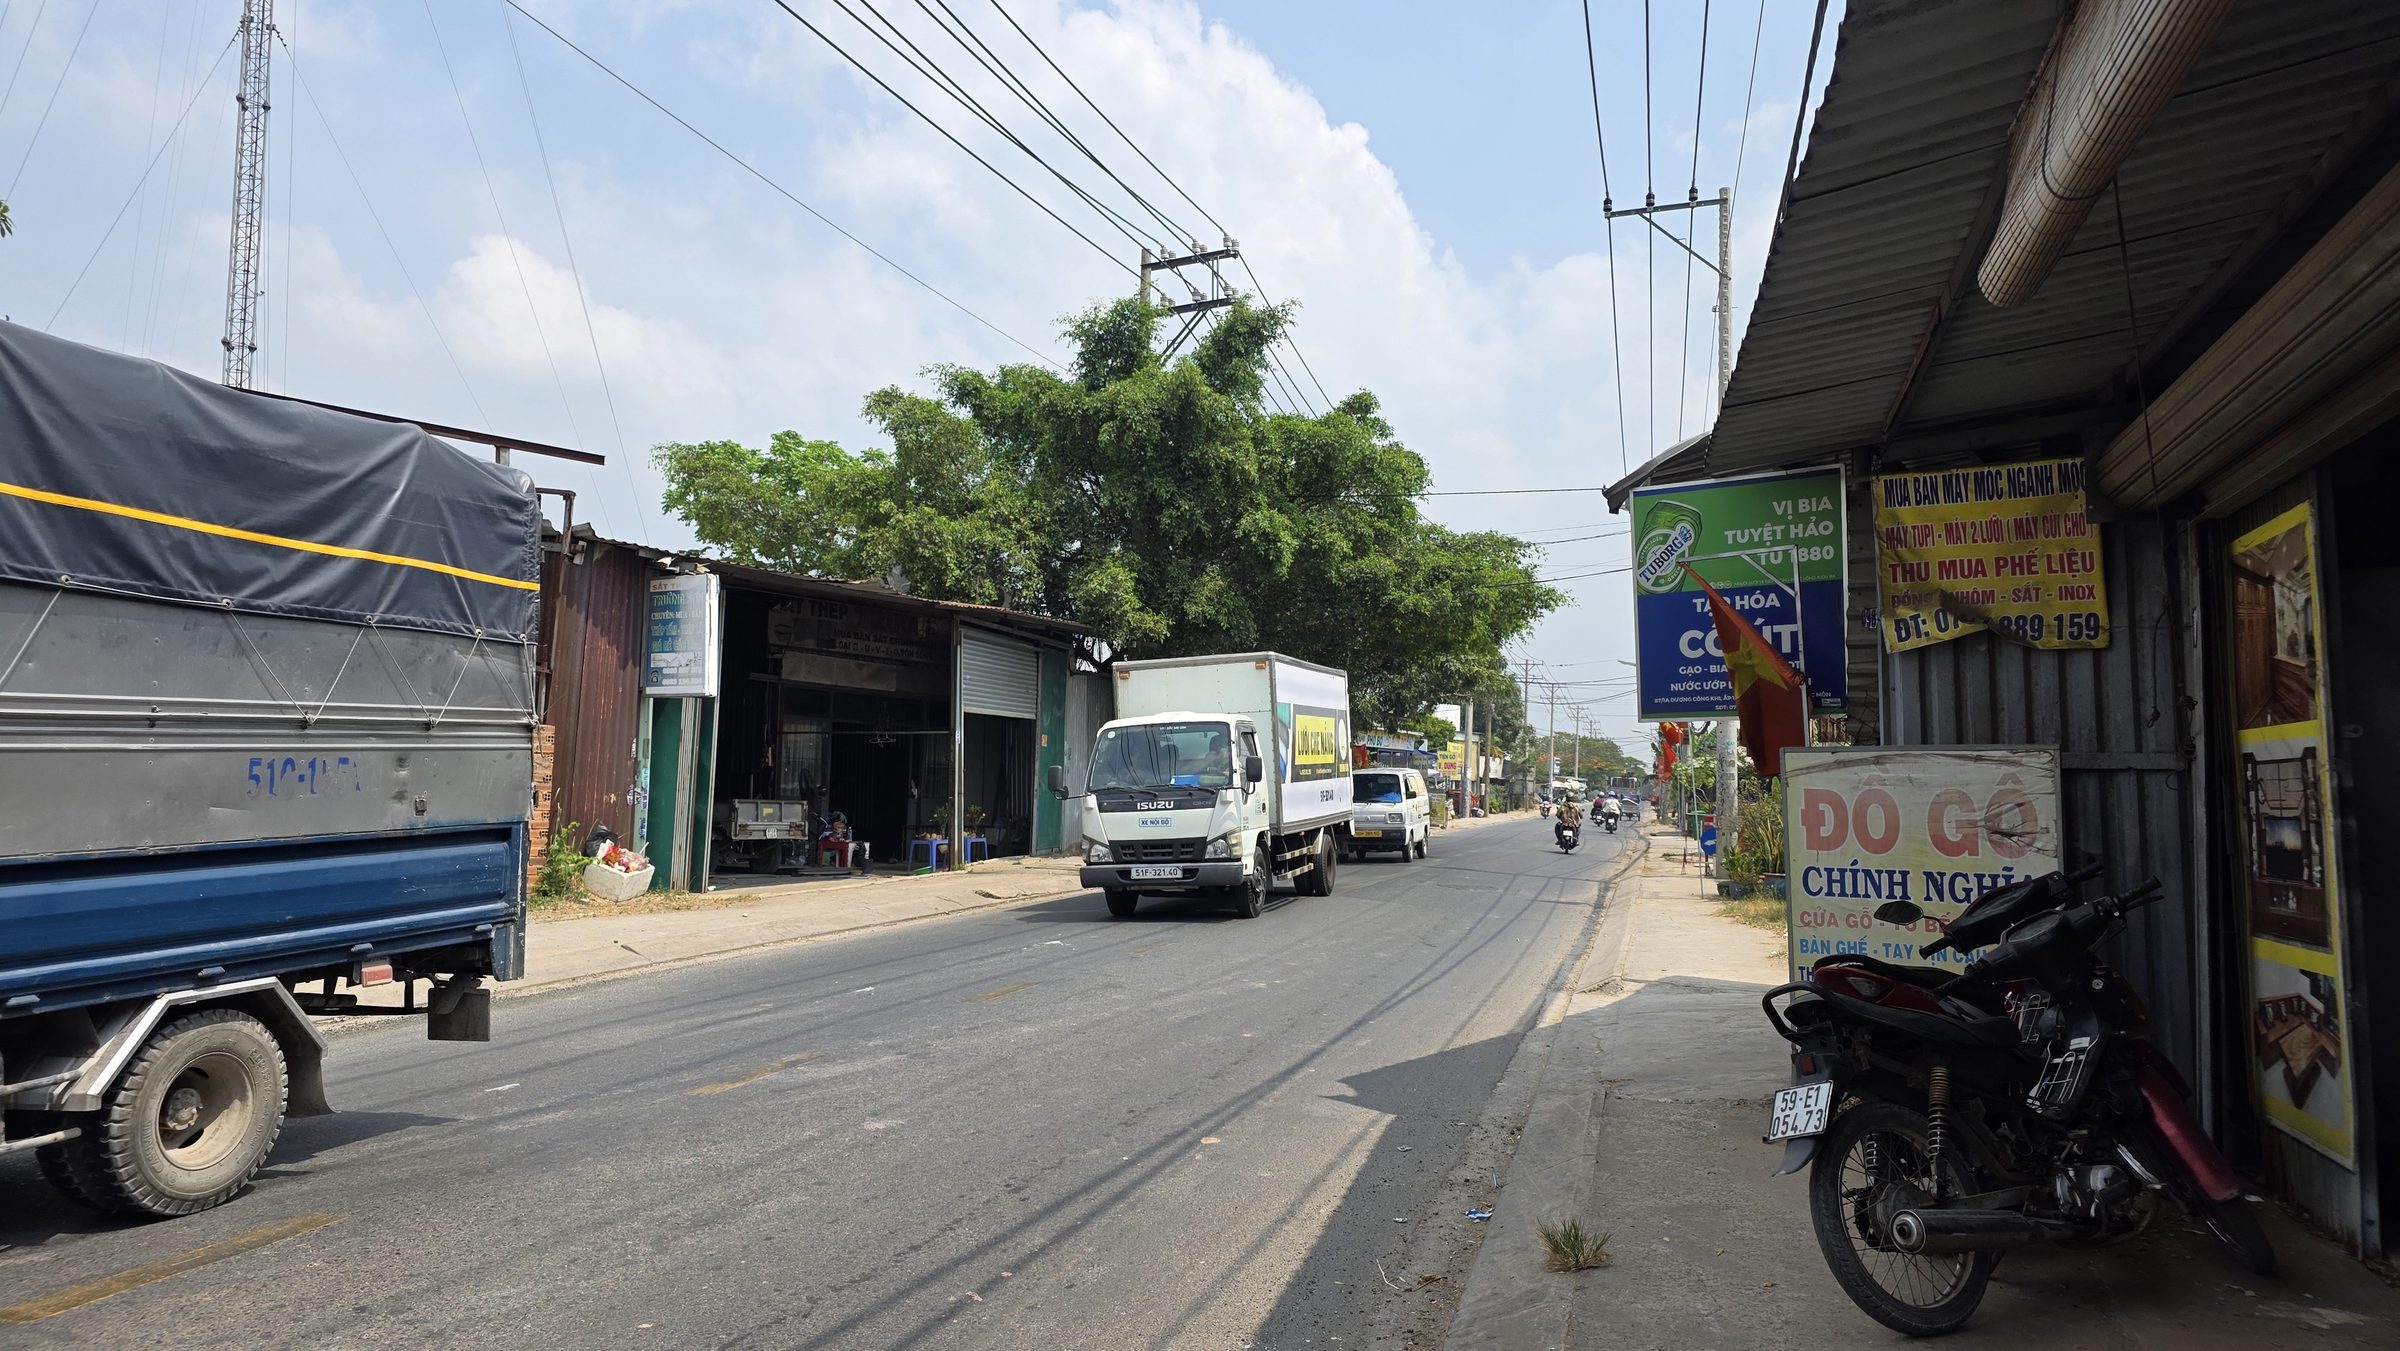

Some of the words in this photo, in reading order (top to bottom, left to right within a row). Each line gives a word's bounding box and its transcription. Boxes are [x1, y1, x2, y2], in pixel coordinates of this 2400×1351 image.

[1884, 477, 1912, 508] MUA
[1914, 471, 1940, 506] BÁN
[1942, 467, 1970, 504] MÁY
[1974, 463, 2003, 502] MÓC
[2006, 461, 2055, 499] NGÀNH
[1772, 500, 1793, 520] VỊ
[1798, 496, 1833, 513] BIA
[1724, 523, 1785, 546] TUYỆT
[1789, 516, 1834, 538] HẢO
[1885, 522, 1908, 550] MÁY
[1911, 523, 1935, 548] TUPI
[1944, 517, 1967, 545] MÁY
[1971, 521, 1978, 544] 2
[2015, 512, 2038, 540] MÁY
[1639, 537, 1684, 583] TUBORG
[1889, 562, 1930, 584] THU
[1938, 558, 1987, 580] MUA
[1994, 547, 2040, 577] PHẾ
[2045, 548, 2095, 579] LIỆU
[1735, 590, 1780, 610] HÓA
[2011, 582, 2042, 604] SẮT
[2058, 584, 2097, 601] INOX
[1894, 613, 1931, 643] ĐT:
[2054, 612, 2101, 641] 159
[1679, 665, 1702, 677] GẠO
[1710, 664, 1728, 673] BIA
[1670, 680, 1701, 692] NƯỚC
[1703, 679, 1727, 690] ƯỚP
[1137, 800, 1174, 810] ISUZU
[1800, 764, 1900, 855] ĐỒ
[1135, 868, 1178, 877] 51F-321.40
[1802, 859, 1911, 902] CHÍNH
[1800, 906, 1839, 928] CỬA
[1845, 907, 1873, 930] GỖ
[1800, 935, 1830, 955] BÀN
[1836, 935, 1868, 956] GHẾ
[1882, 943, 1914, 960] TAY
[1771, 1108, 1824, 1137] 054.73
